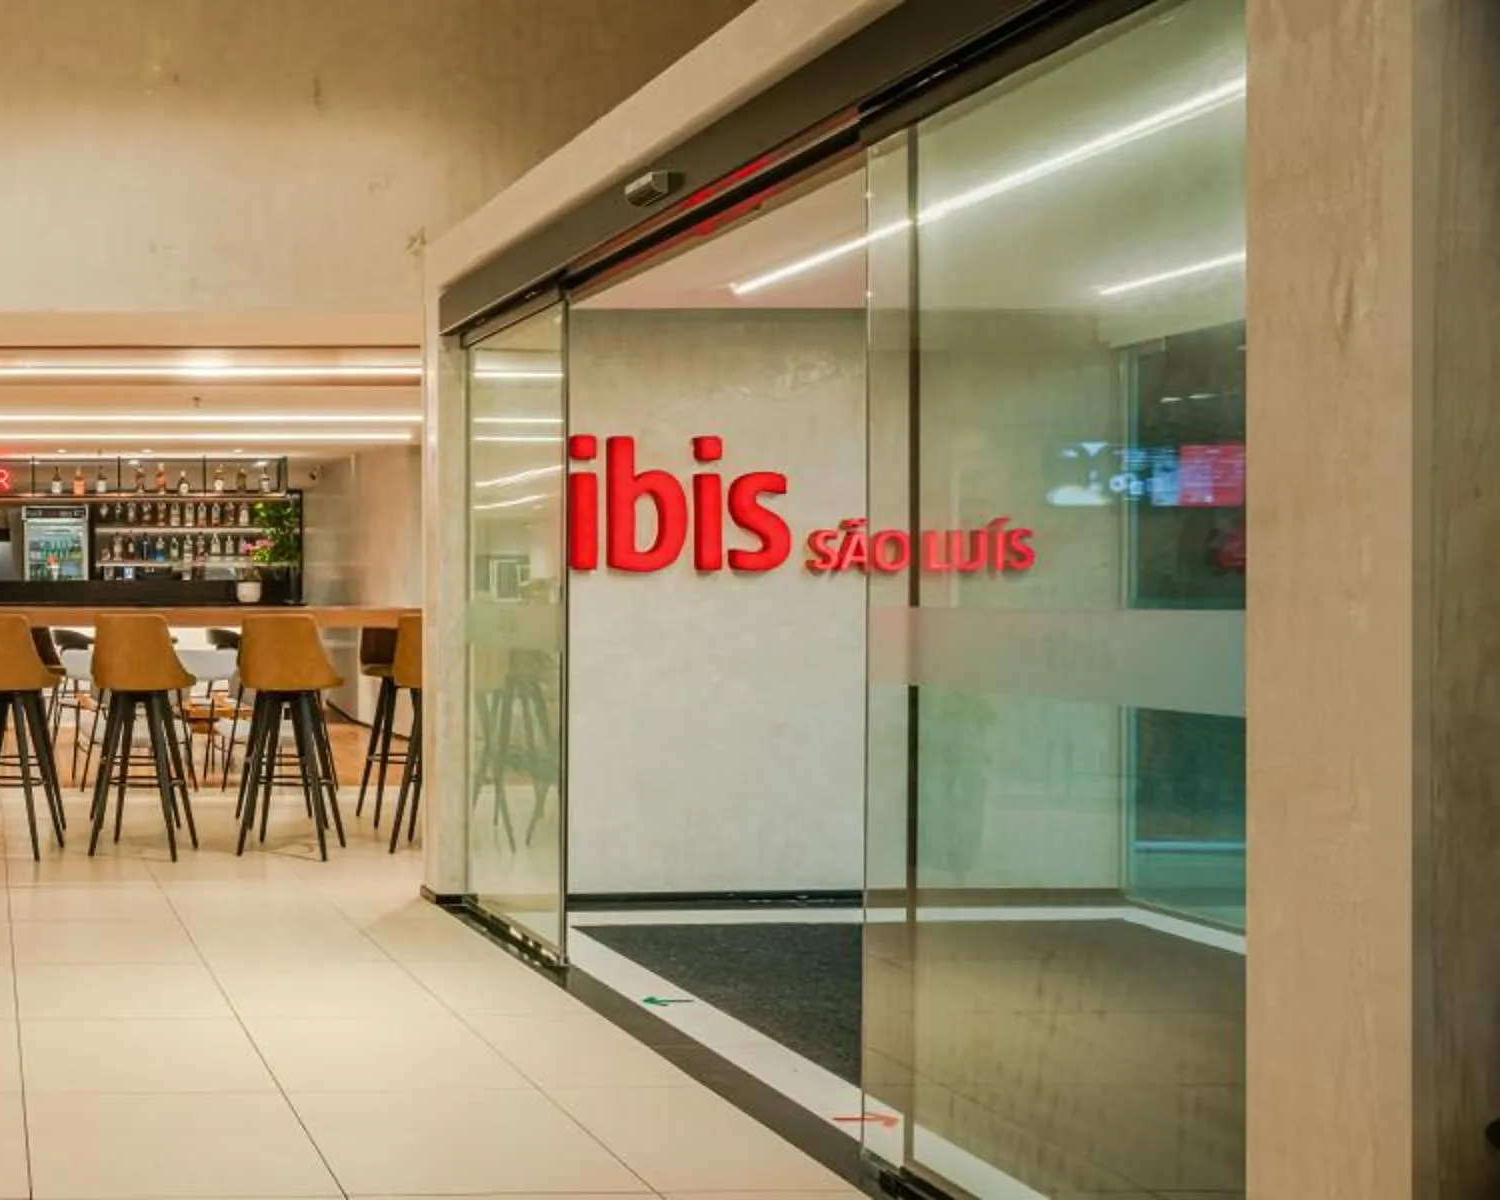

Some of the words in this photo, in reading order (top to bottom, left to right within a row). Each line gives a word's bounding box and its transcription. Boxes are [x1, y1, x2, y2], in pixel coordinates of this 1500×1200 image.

[568, 435, 792, 573] ibis
[807, 518, 911, 573] SÃO
[922, 517, 1036, 572] LUÍS
